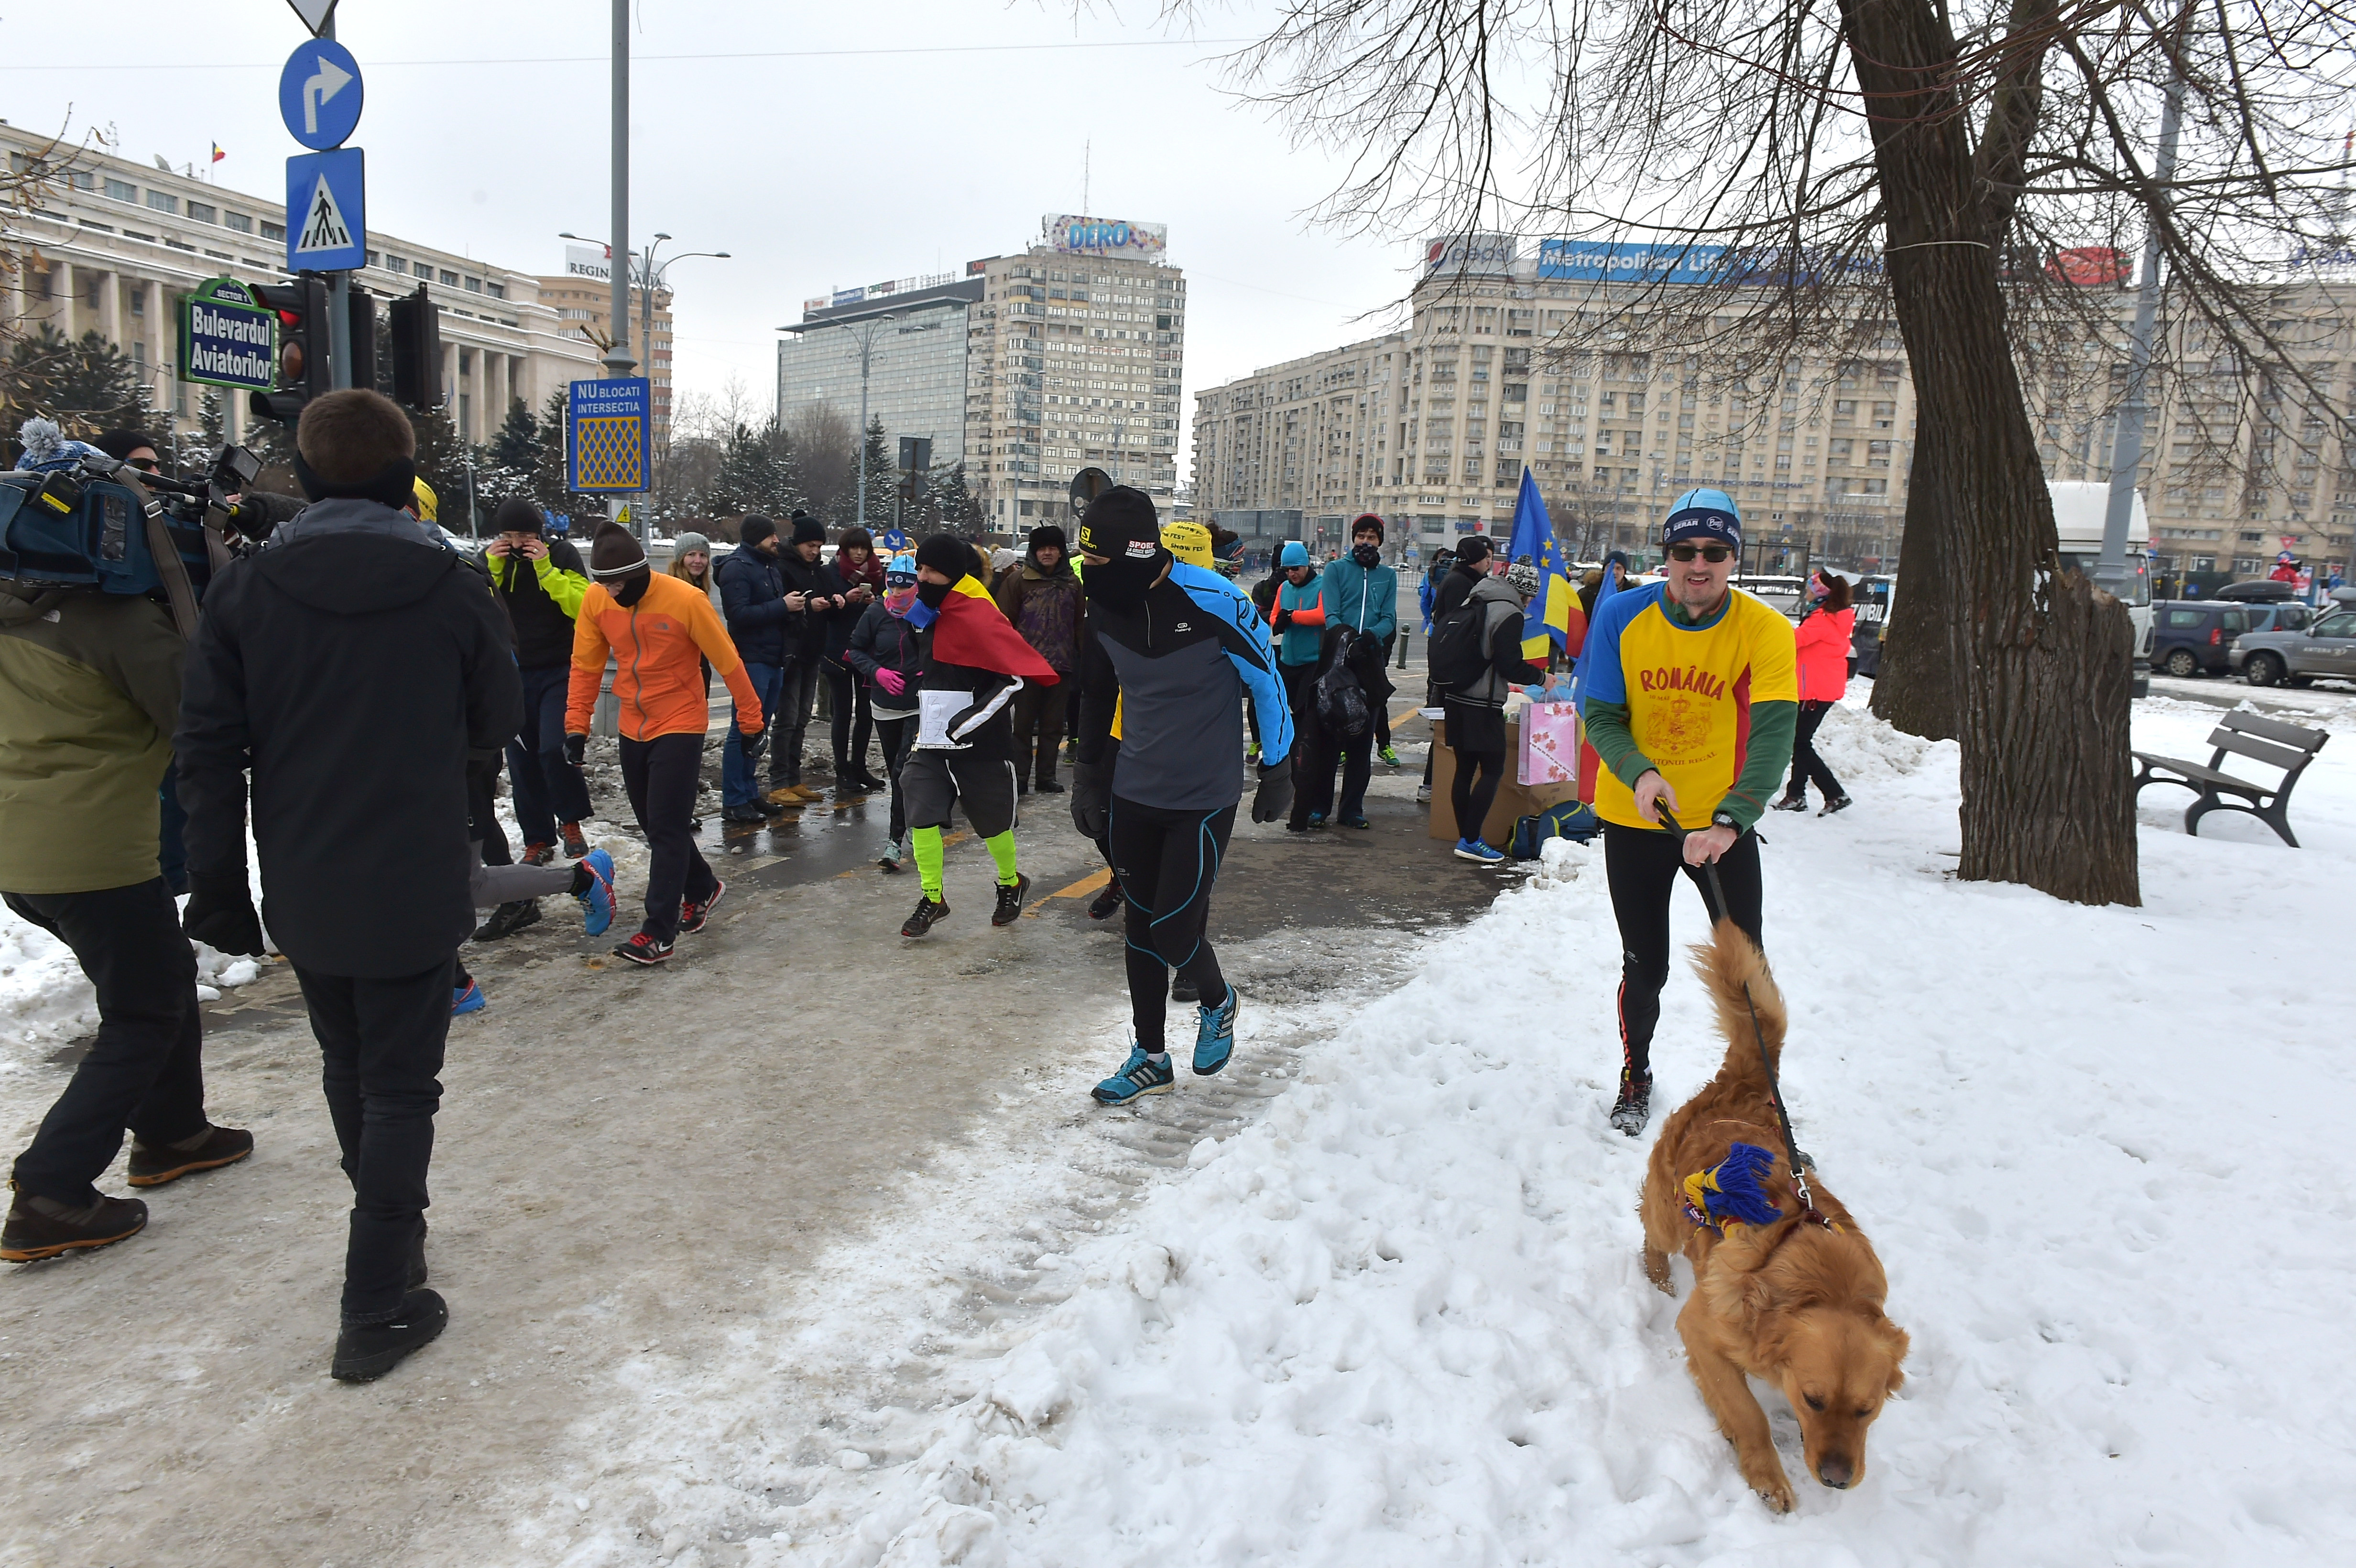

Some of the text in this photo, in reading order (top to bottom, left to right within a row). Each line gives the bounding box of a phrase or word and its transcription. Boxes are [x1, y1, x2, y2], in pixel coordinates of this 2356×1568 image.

[1069, 223, 1129, 249] DERO
[1451, 244, 1509, 265] pepsi
[1542, 248, 1682, 273] Metropolitan
[570, 262, 610, 278] REGIN
[217, 289, 242, 301] SECTOR
[193, 305, 270, 346] Bulevardul
[191, 342, 271, 380] Aviatorilor
[578, 383, 640, 399] NU BLOCATI
[578, 402, 640, 414] INTERSECTIA
[1673, 520, 1699, 532] GERAR
[1128, 541, 1155, 549] SPORT
[1170, 543, 1191, 551] SNOW
[1640, 665, 1726, 701] ROMÂNIA
[1647, 757, 1687, 766] ATONUL
[1689, 751, 1718, 765] REGAL
